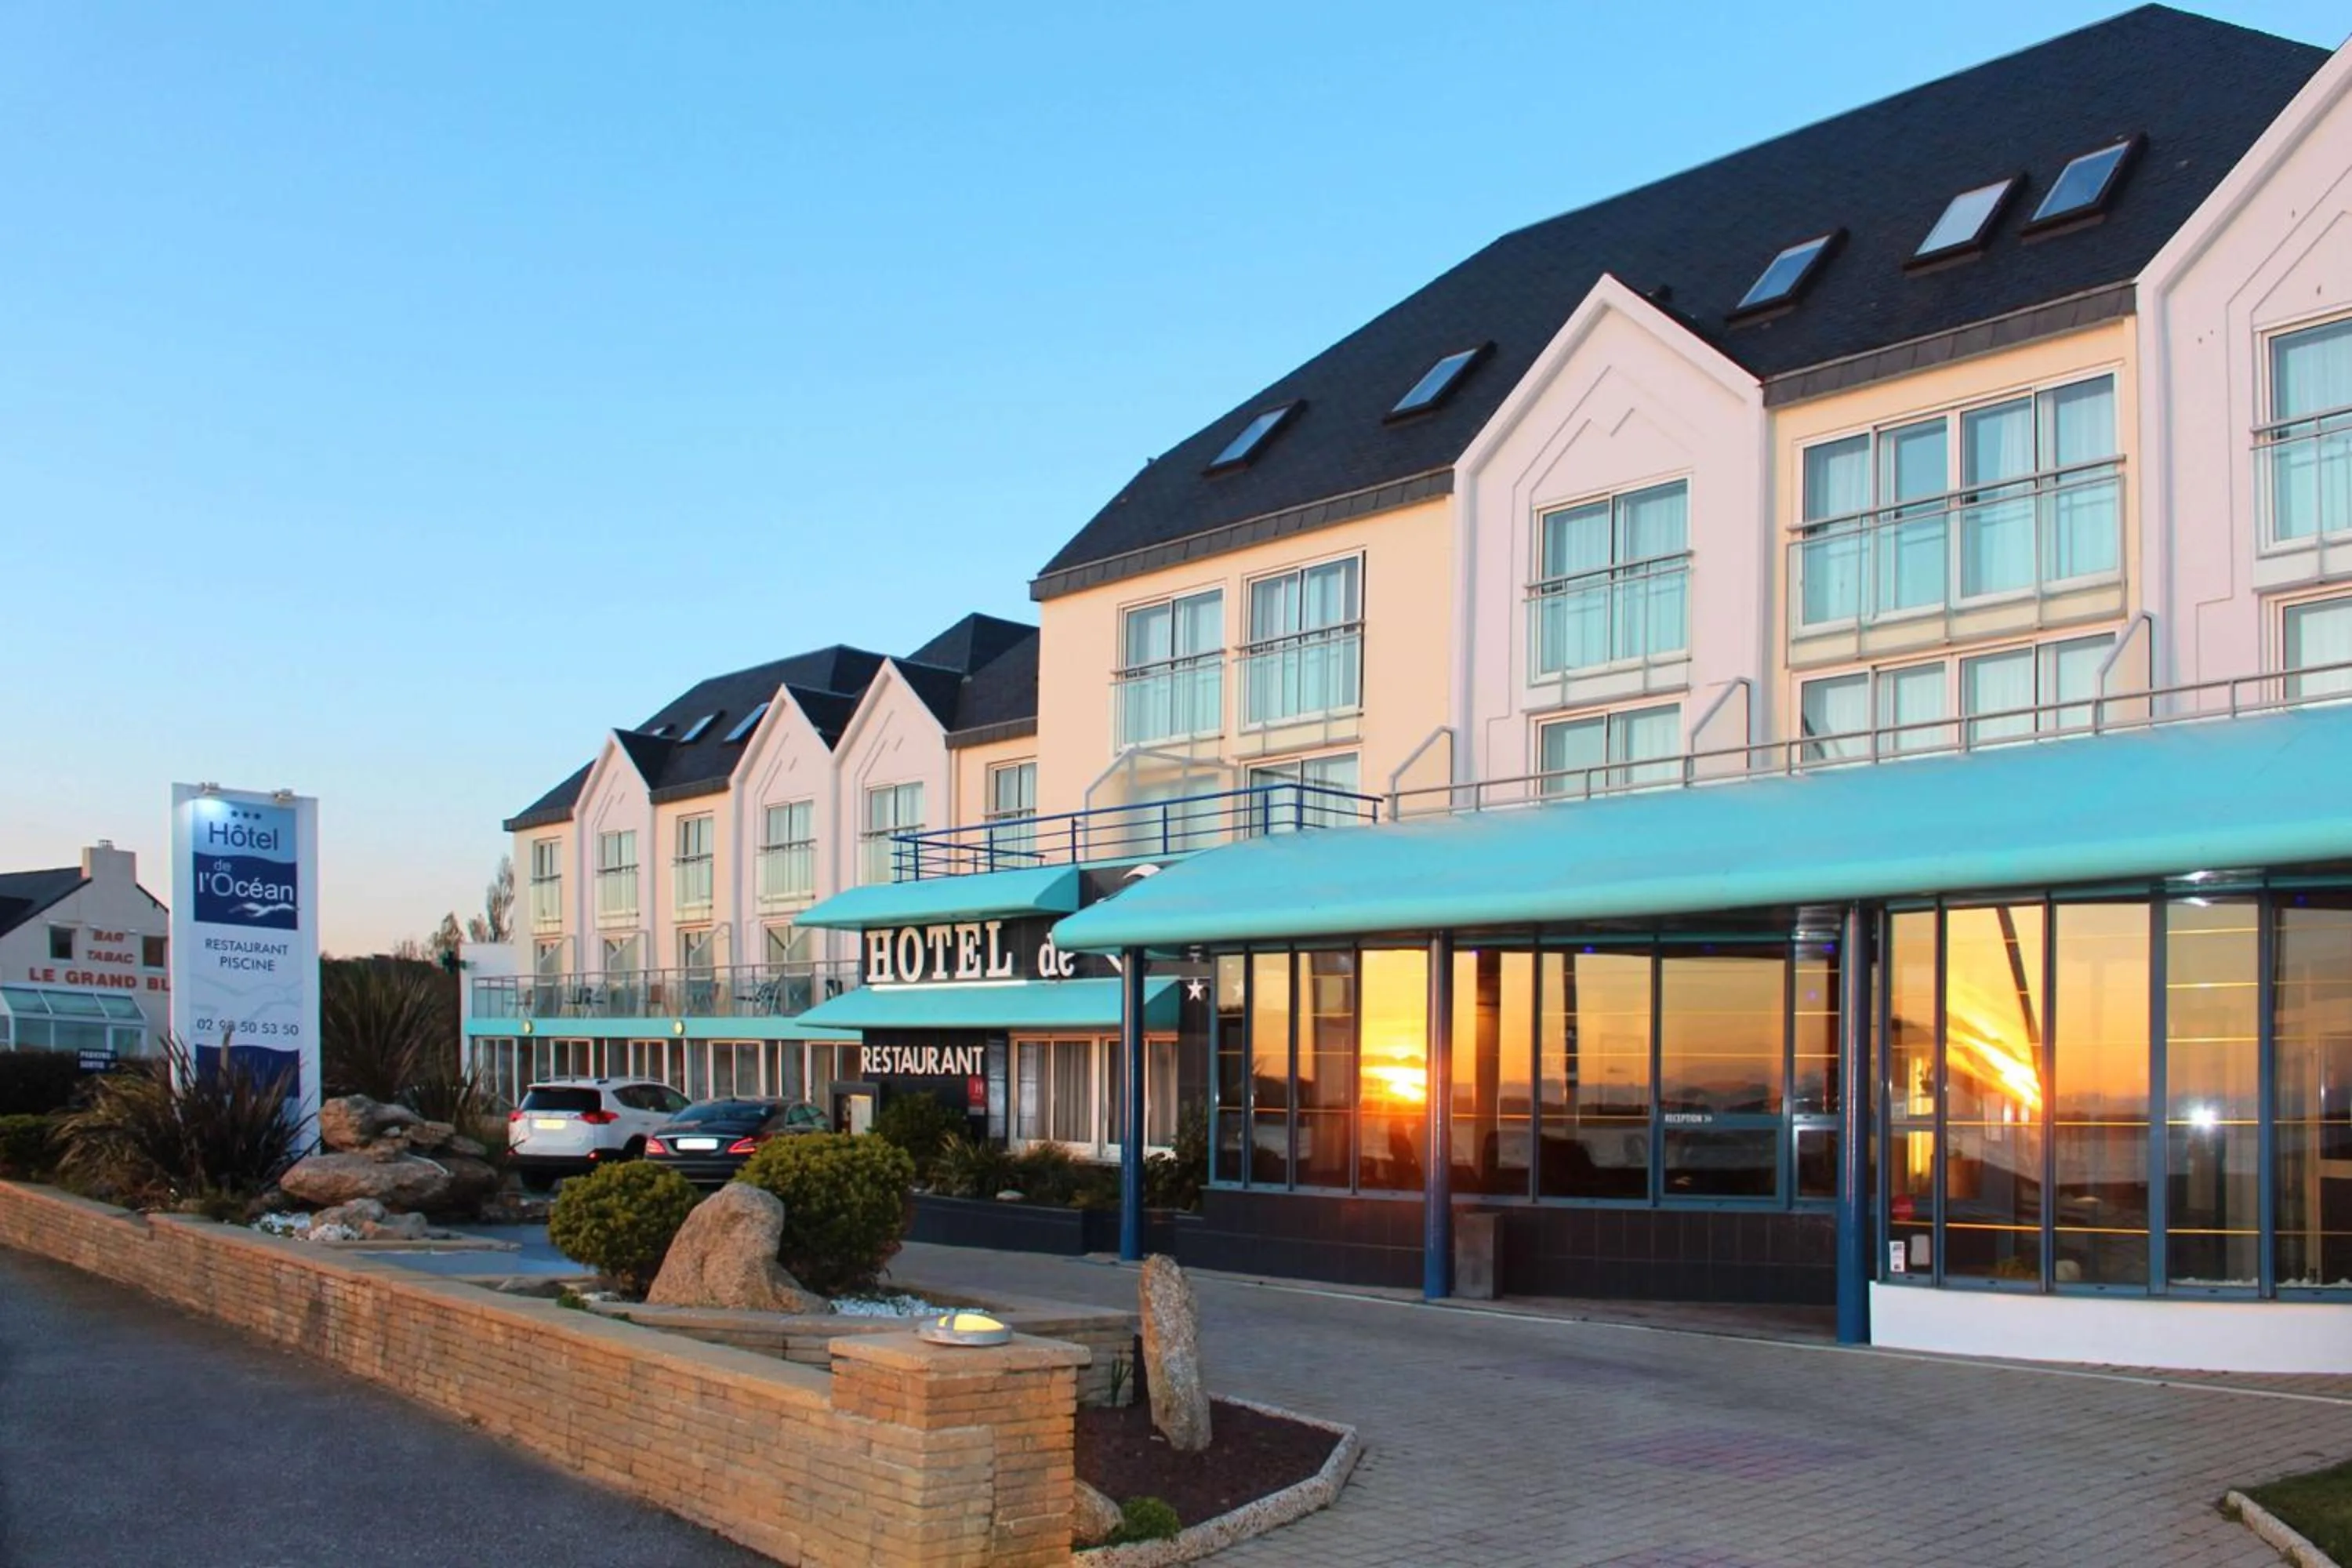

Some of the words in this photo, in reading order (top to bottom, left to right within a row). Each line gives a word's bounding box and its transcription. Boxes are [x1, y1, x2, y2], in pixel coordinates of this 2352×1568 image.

[209, 822, 278, 851] Hôtel
[213, 859, 232, 872] de
[199, 871, 293, 902] l'Océan
[93, 931, 124, 942] BAR
[205, 938, 289, 955] RESTAURANT
[866, 920, 1013, 983] HOTEL
[87, 949, 135, 964] TABAC
[220, 956, 275, 971] PISCINE
[29, 967, 55, 982] LE
[64, 970, 136, 989] GRAND
[196, 1018, 213, 1031] 02
[240, 1021, 257, 1033] 50
[261, 1022, 278, 1034] 53
[282, 1024, 299, 1036] 50
[861, 1045, 984, 1075] RESTAURANT
